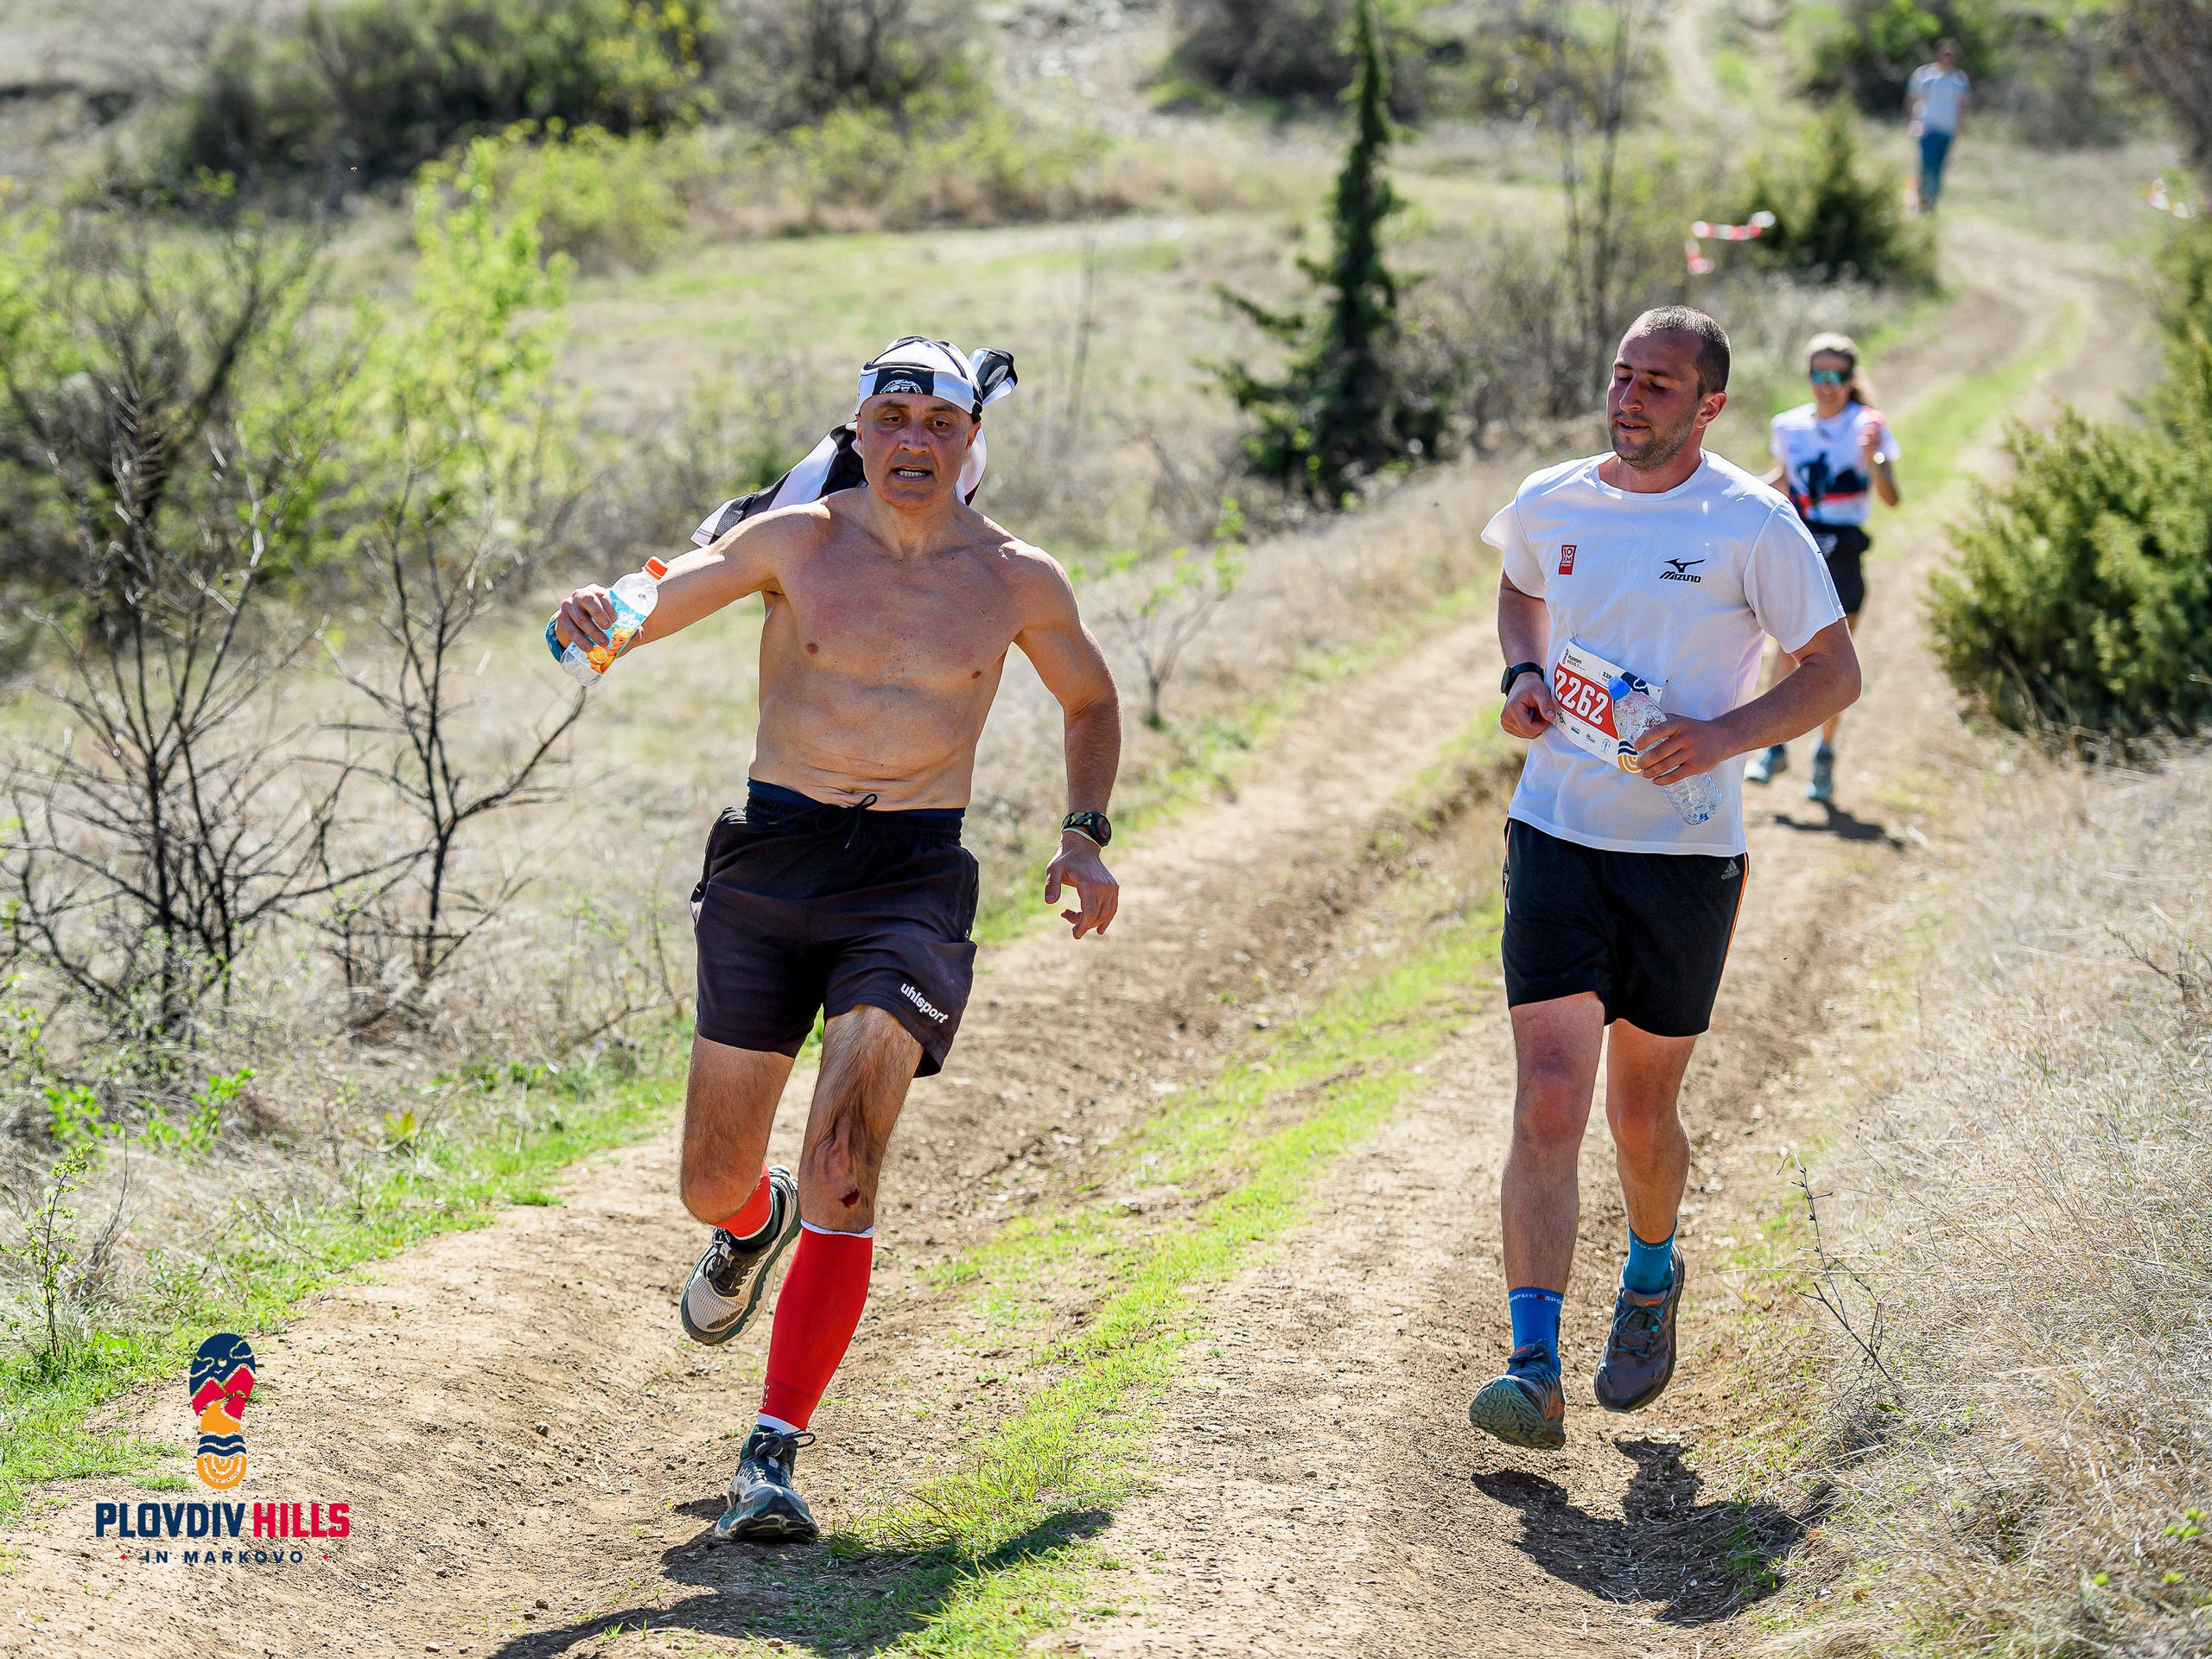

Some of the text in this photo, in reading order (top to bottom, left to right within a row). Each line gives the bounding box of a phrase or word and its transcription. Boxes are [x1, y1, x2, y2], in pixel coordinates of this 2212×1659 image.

[1563, 548, 1573, 556] 10
[1555, 669, 1609, 725] 2262
[900, 982, 949, 1023] uhlsport
